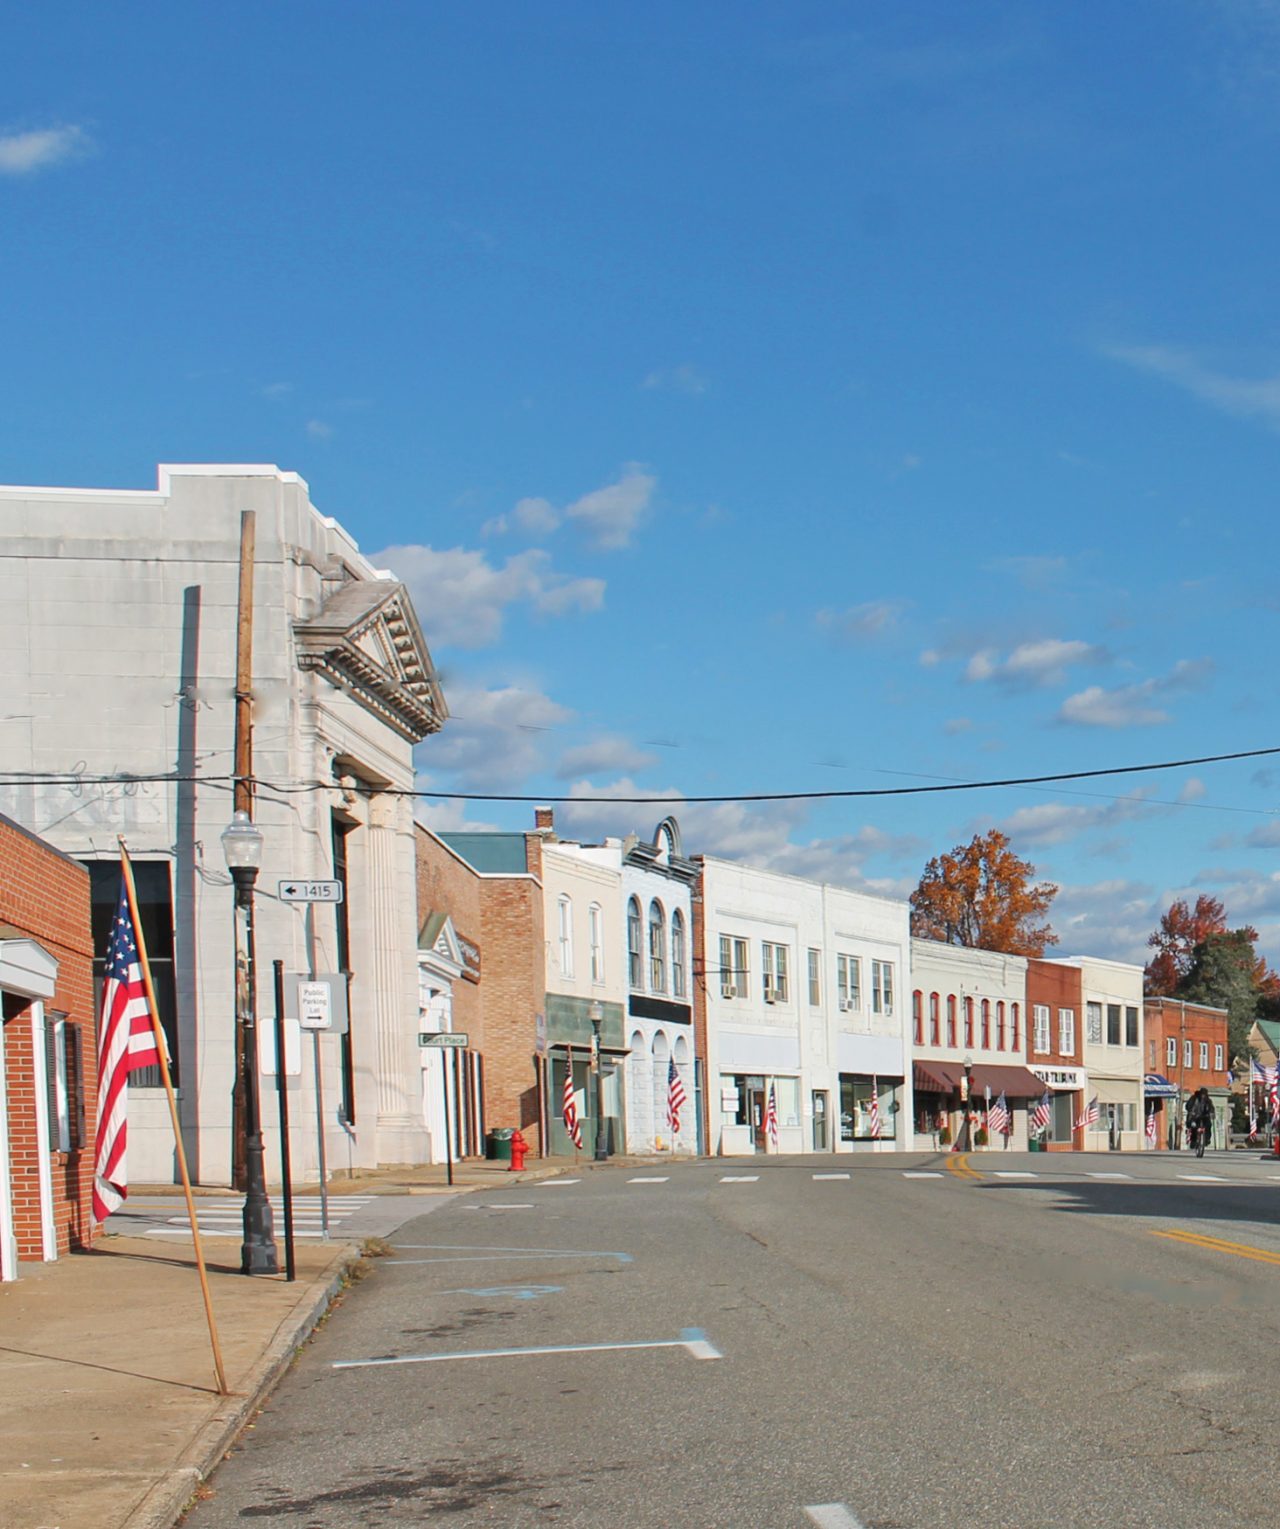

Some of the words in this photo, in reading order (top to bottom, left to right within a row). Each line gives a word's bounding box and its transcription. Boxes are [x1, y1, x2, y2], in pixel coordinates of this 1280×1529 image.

[304, 885, 331, 897] 1415
[302, 998, 327, 1006] Parking
[444, 1036, 465, 1044] Place
